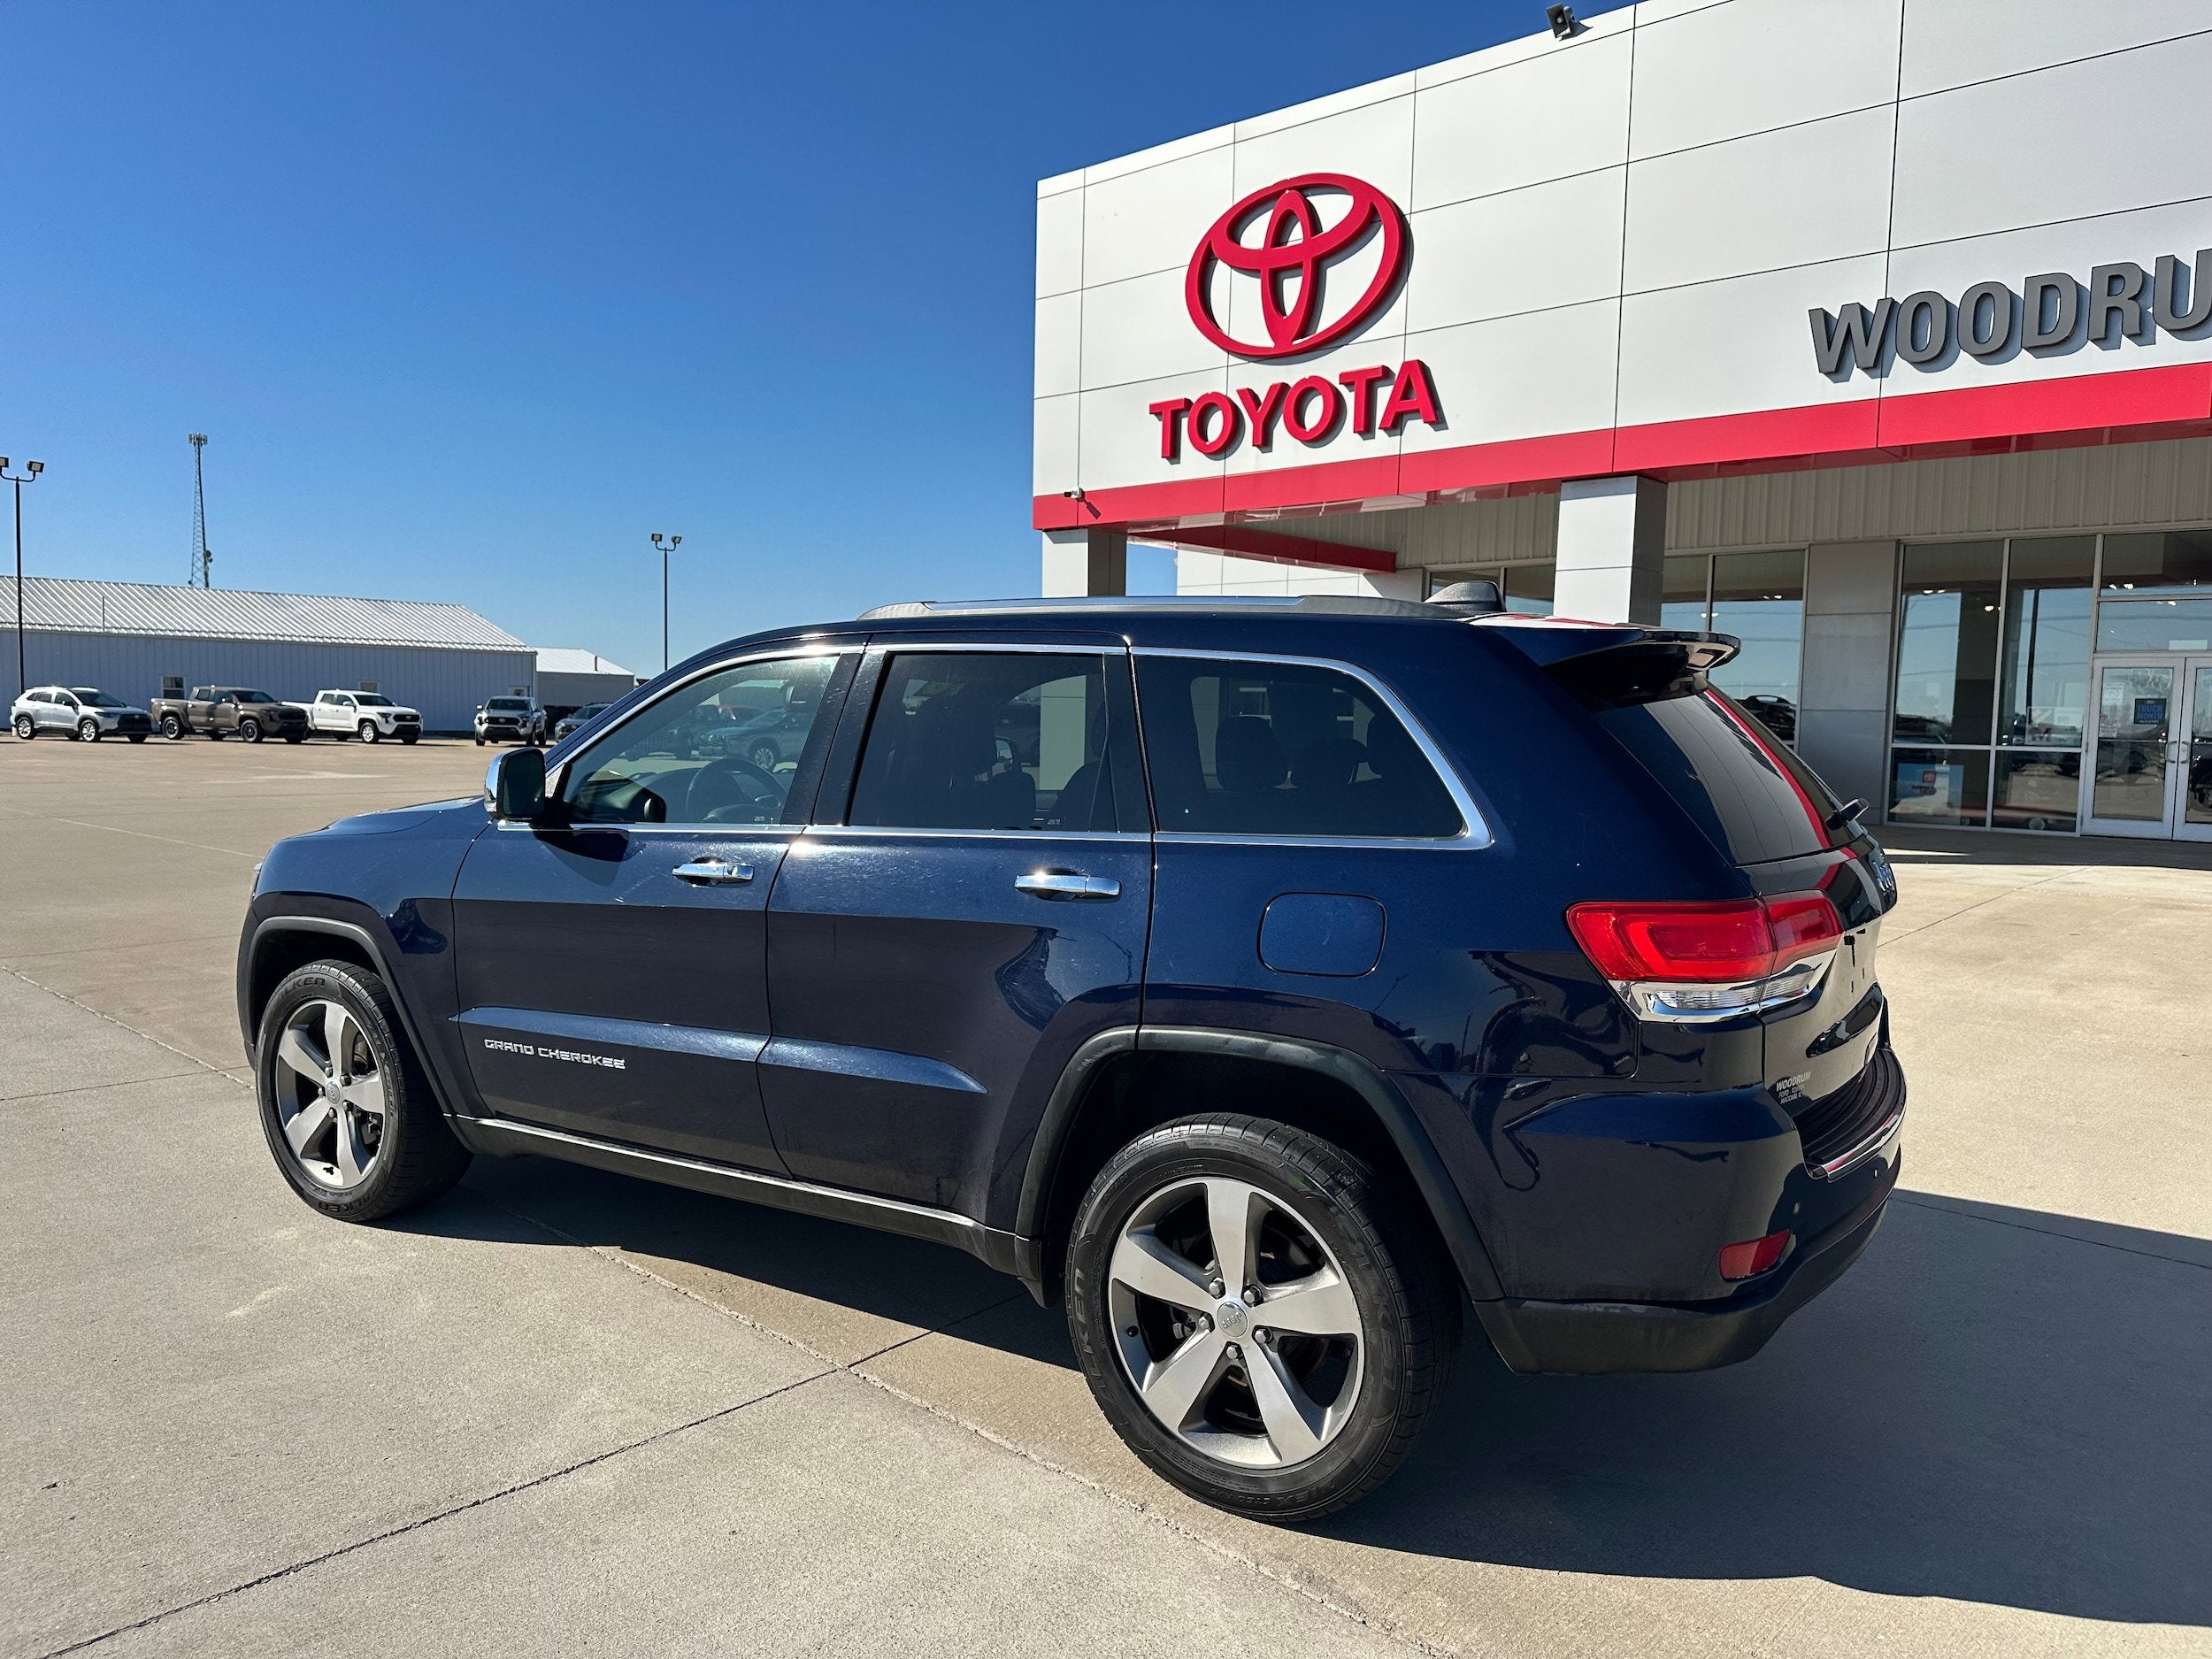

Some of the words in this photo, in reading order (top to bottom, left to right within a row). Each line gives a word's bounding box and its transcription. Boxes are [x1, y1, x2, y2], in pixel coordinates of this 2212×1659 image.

[1809, 249, 2212, 374] WOODRU
[1149, 359, 1439, 459] TOYOTA
[484, 1039, 534, 1056] GRAND
[537, 1047, 626, 1070] CHEROKEE
